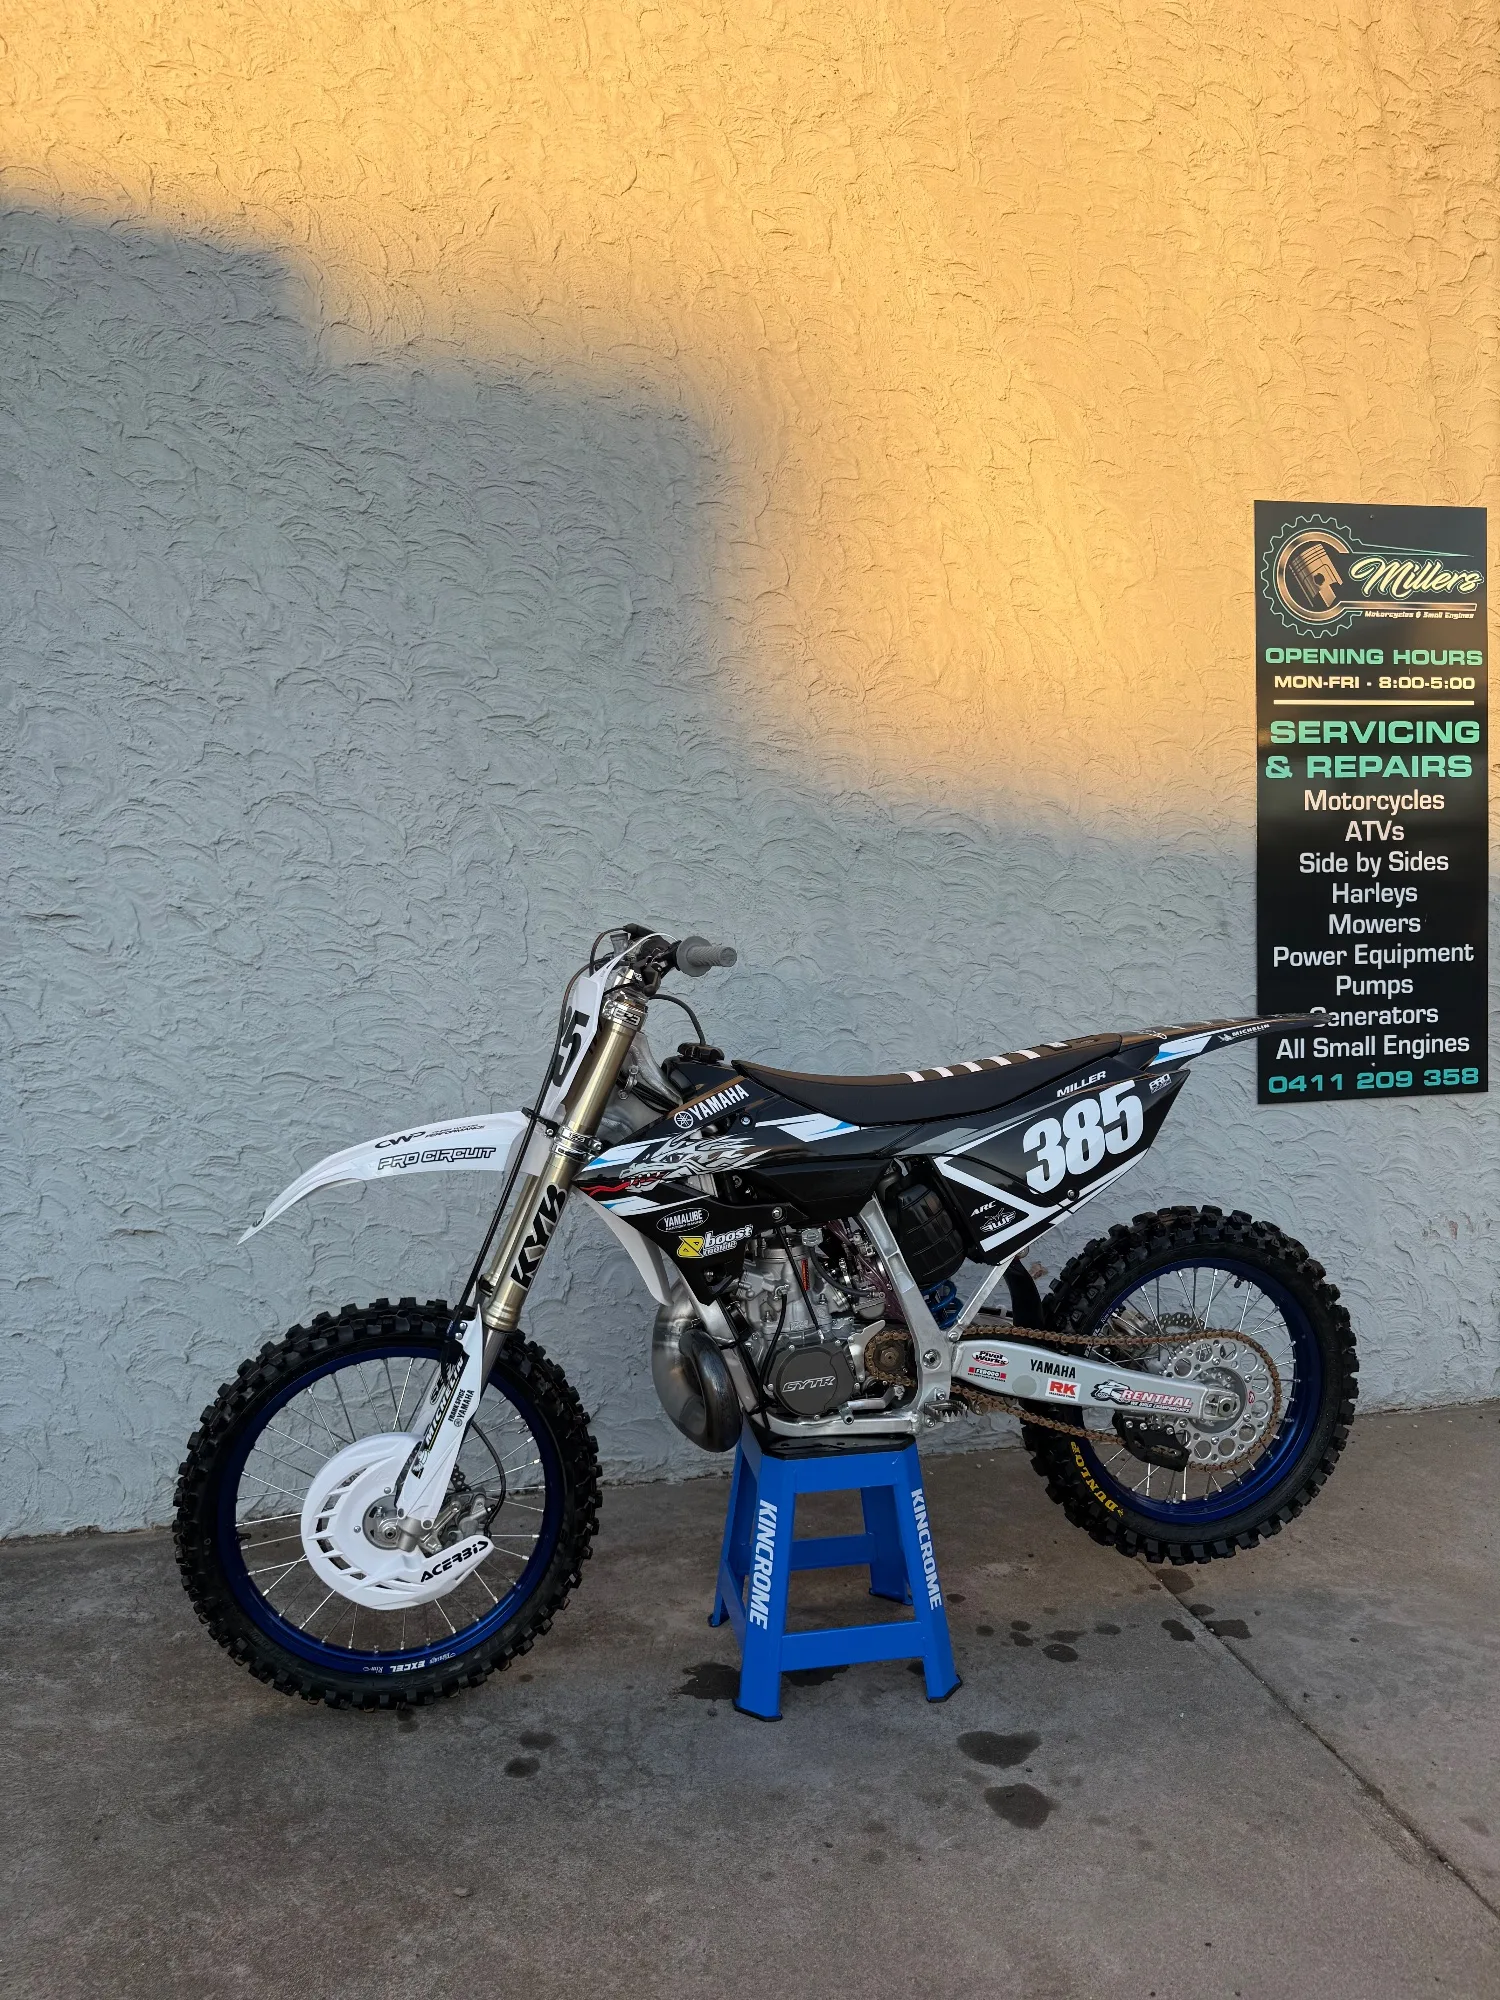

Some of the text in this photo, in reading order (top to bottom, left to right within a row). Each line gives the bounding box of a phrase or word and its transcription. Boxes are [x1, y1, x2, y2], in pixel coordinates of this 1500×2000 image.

[1350, 555, 1483, 599] Millers
[1365, 610, 1414, 619] Motorcycles
[1423, 611, 1443, 619] Small
[1445, 612, 1475, 620] Engines
[1265, 647, 1483, 666] OPENING HOURS
[1274, 675, 1360, 689] MON-FRI
[1378, 676, 1476, 690] 8:00-5:00
[1270, 720, 1480, 744] SERVICING
[1265, 755, 1473, 779] & REPAIRS
[1304, 788, 1445, 816] Motorcycles
[1344, 820, 1405, 842] ATVs
[1299, 850, 1450, 878] Side by Sides
[1332, 881, 1418, 908] Harleys
[1328, 913, 1421, 935] Mowers
[1273, 943, 1474, 970] Power Equipment
[1336, 975, 1414, 999] Pumps
[1232, 1023, 1270, 1037] MICHELIN
[1276, 1034, 1470, 1060] All Small Engines
[1056, 1070, 1107, 1098] MILLER
[1268, 1067, 1479, 1094] 0411 209 358
[688, 1083, 750, 1121] YAMAHA
[1023, 1079, 1143, 1195] 385
[378, 1147, 496, 1170] PRO CIRCUIT
[664, 1210, 703, 1228] YAMALUBE
[970, 1200, 996, 1217] ARC
[510, 1184, 567, 1291] KYB
[704, 1224, 754, 1249] boost
[1030, 1359, 1076, 1379] YAMAHA
[782, 1375, 836, 1392] GYTR
[1049, 1380, 1078, 1395] RK
[425, 1355, 464, 1444] MICHELIN
[457, 1389, 475, 1419] YAMAHA
[1121, 1389, 1194, 1408] RENTHAL
[1070, 1441, 1119, 1512] DUNLOP
[911, 1487, 942, 1611] KINCROME
[749, 1498, 778, 1630] KINCROME
[390, 1660, 426, 1673] EXCEL
